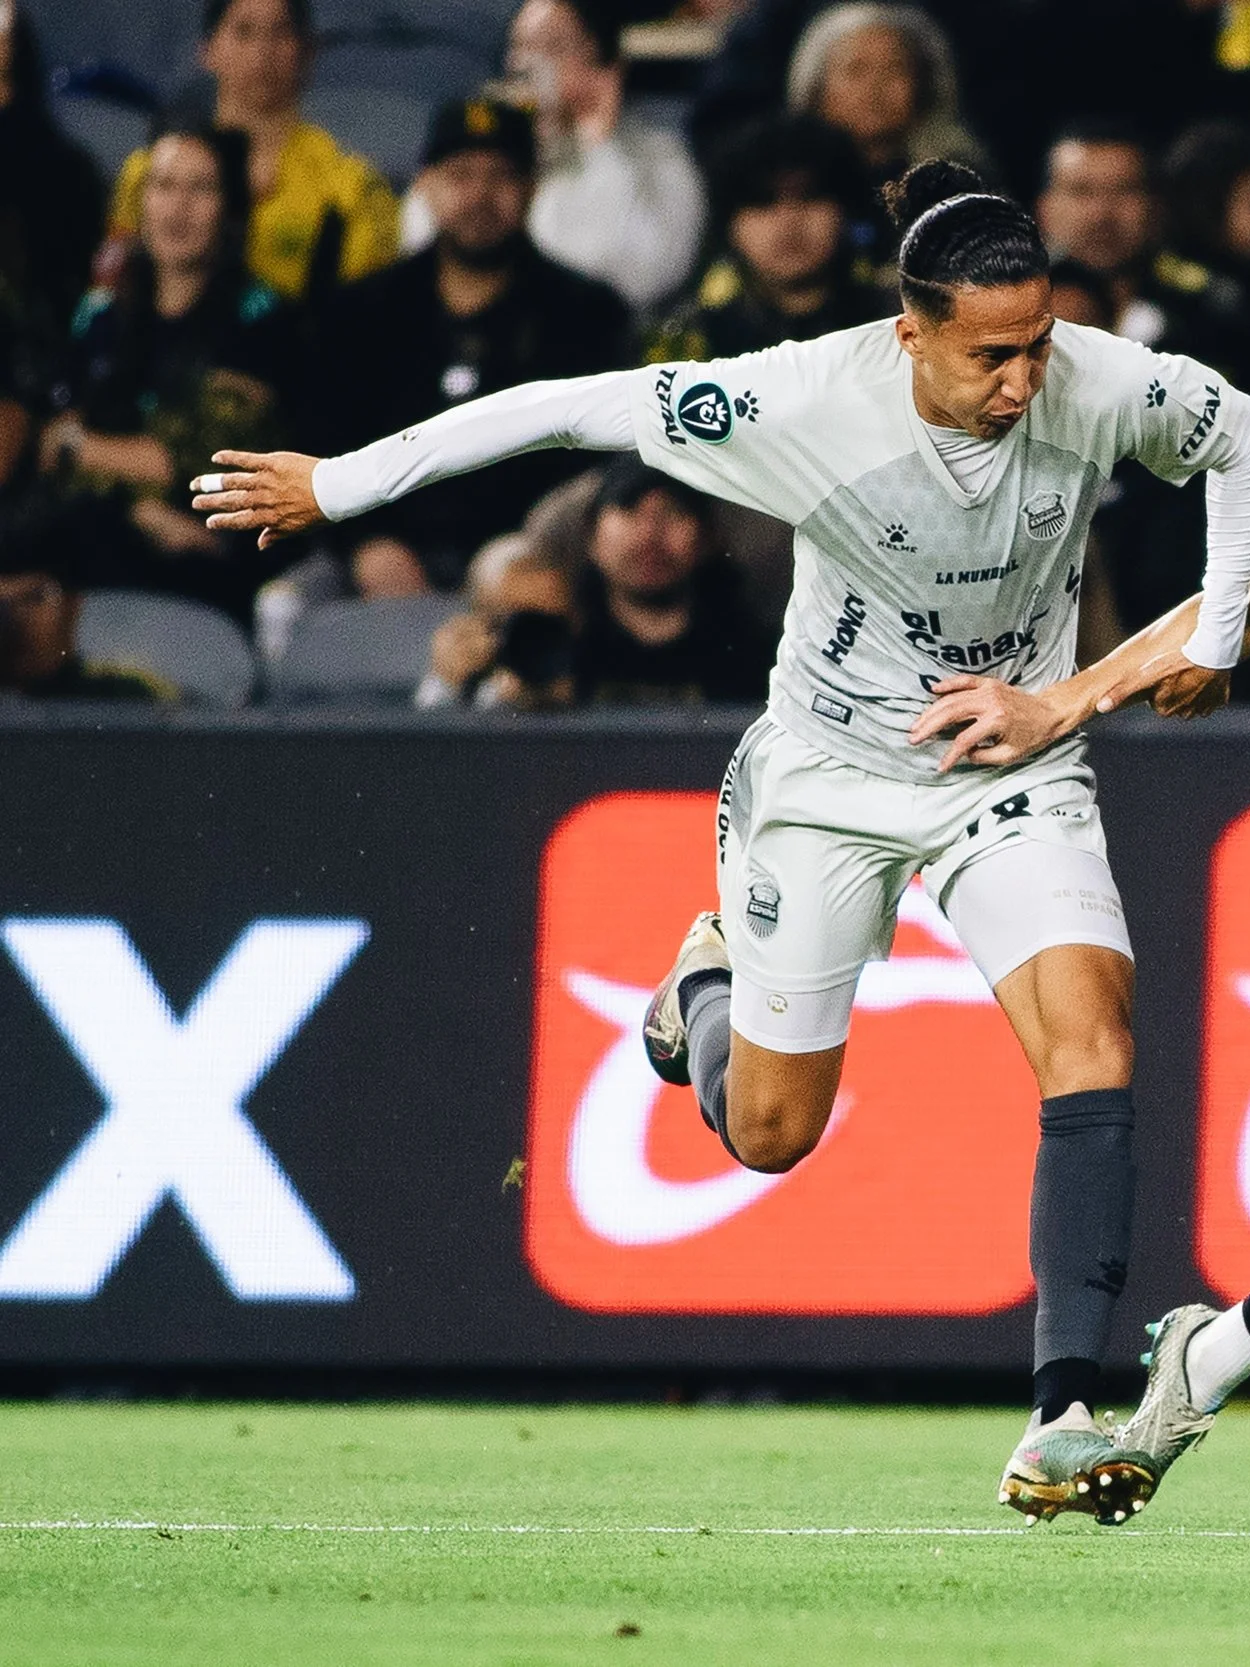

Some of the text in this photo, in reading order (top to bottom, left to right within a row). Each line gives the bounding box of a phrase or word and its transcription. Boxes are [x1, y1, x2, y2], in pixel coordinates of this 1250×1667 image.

[877, 540, 918, 553] KELME
[935, 572, 954, 584] LA
[0, 915, 372, 1300] X
